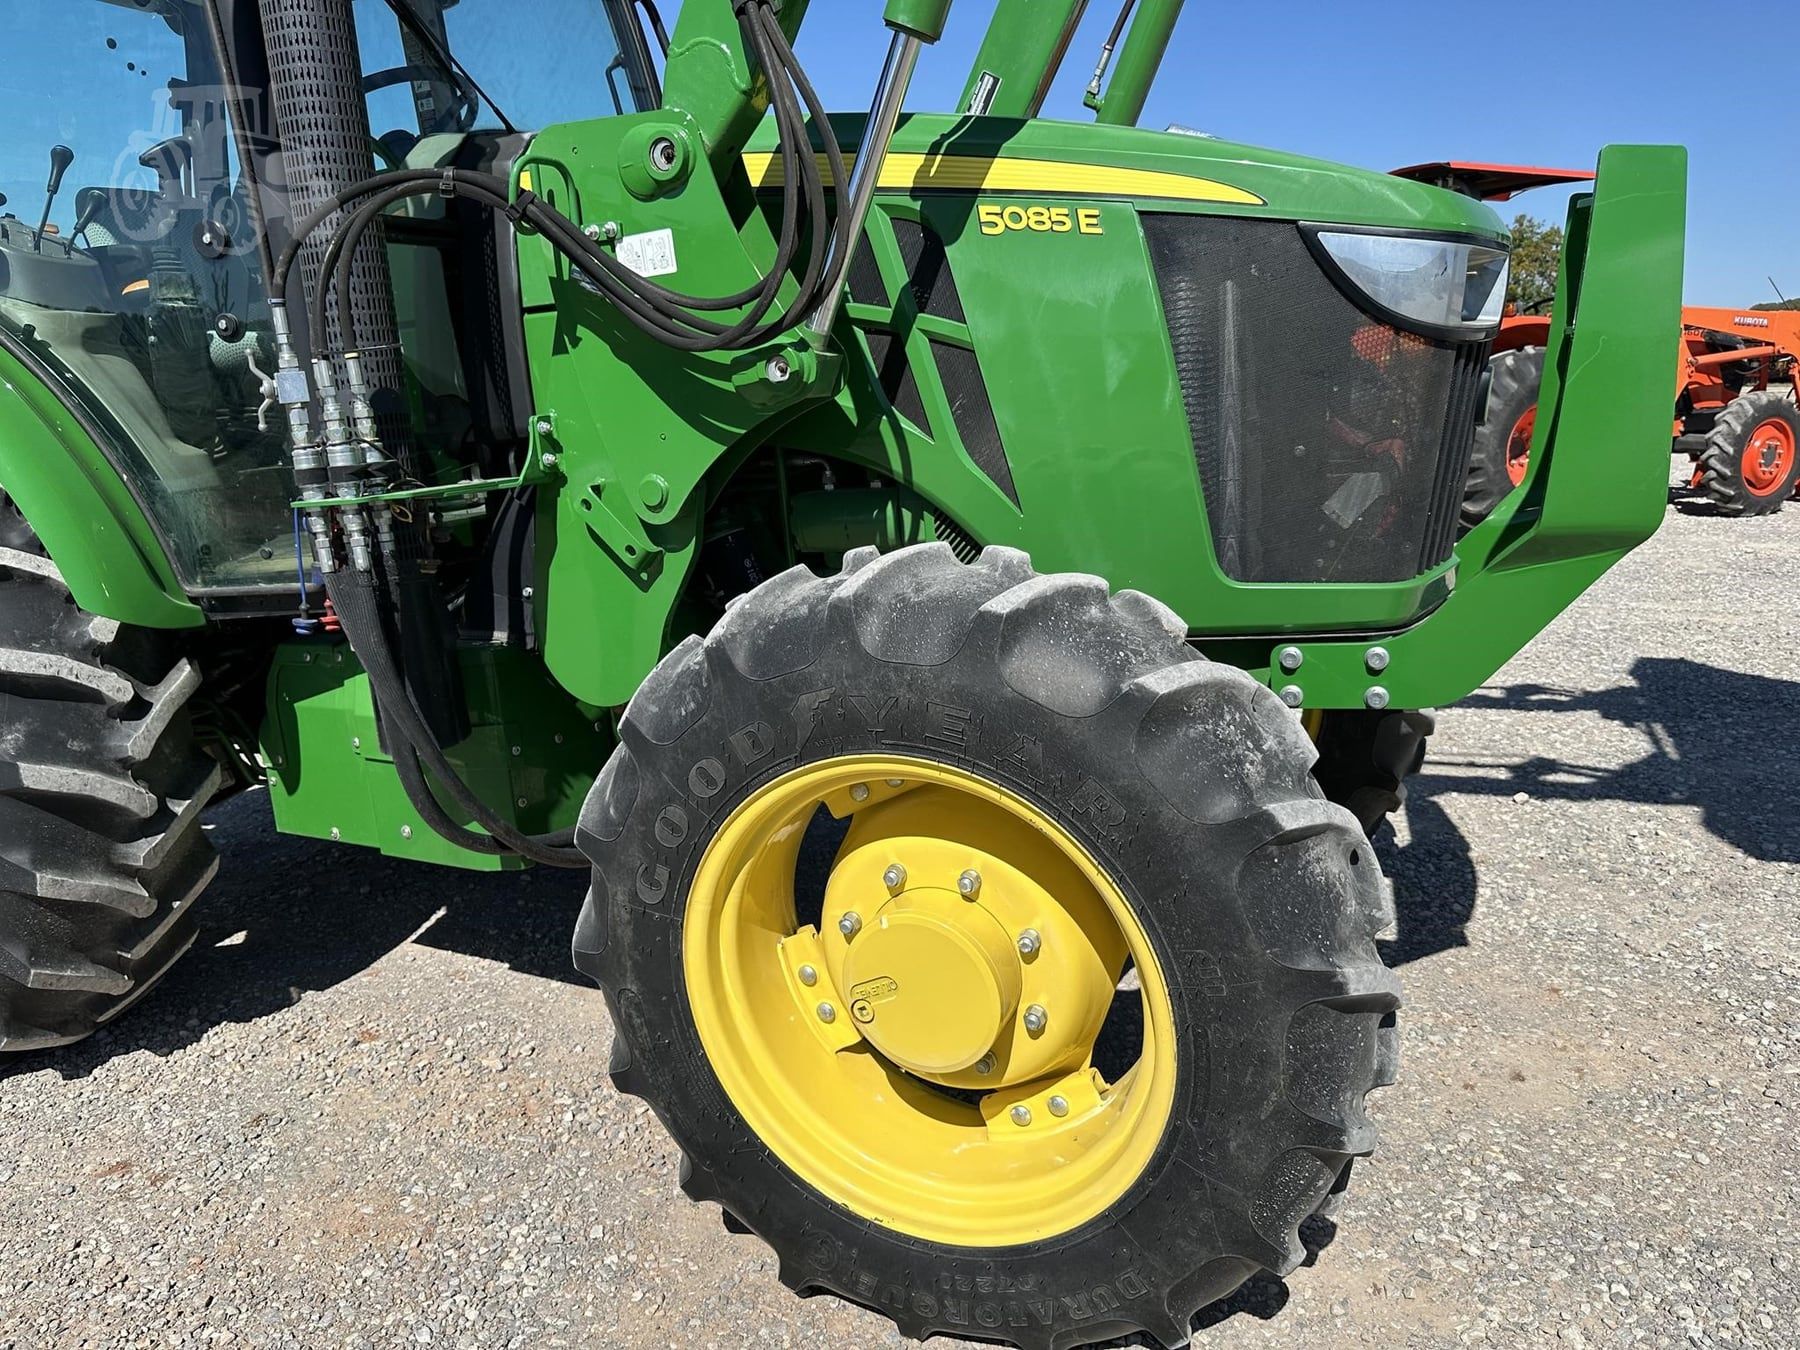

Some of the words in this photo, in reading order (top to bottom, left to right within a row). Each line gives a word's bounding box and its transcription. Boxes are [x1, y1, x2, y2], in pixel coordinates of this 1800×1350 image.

[977, 205, 1072, 235] 5085
[1076, 207, 1103, 235] E
[1733, 315, 1769, 328] KUBOTA
[855, 1266, 1154, 1328] DURATORQUE
